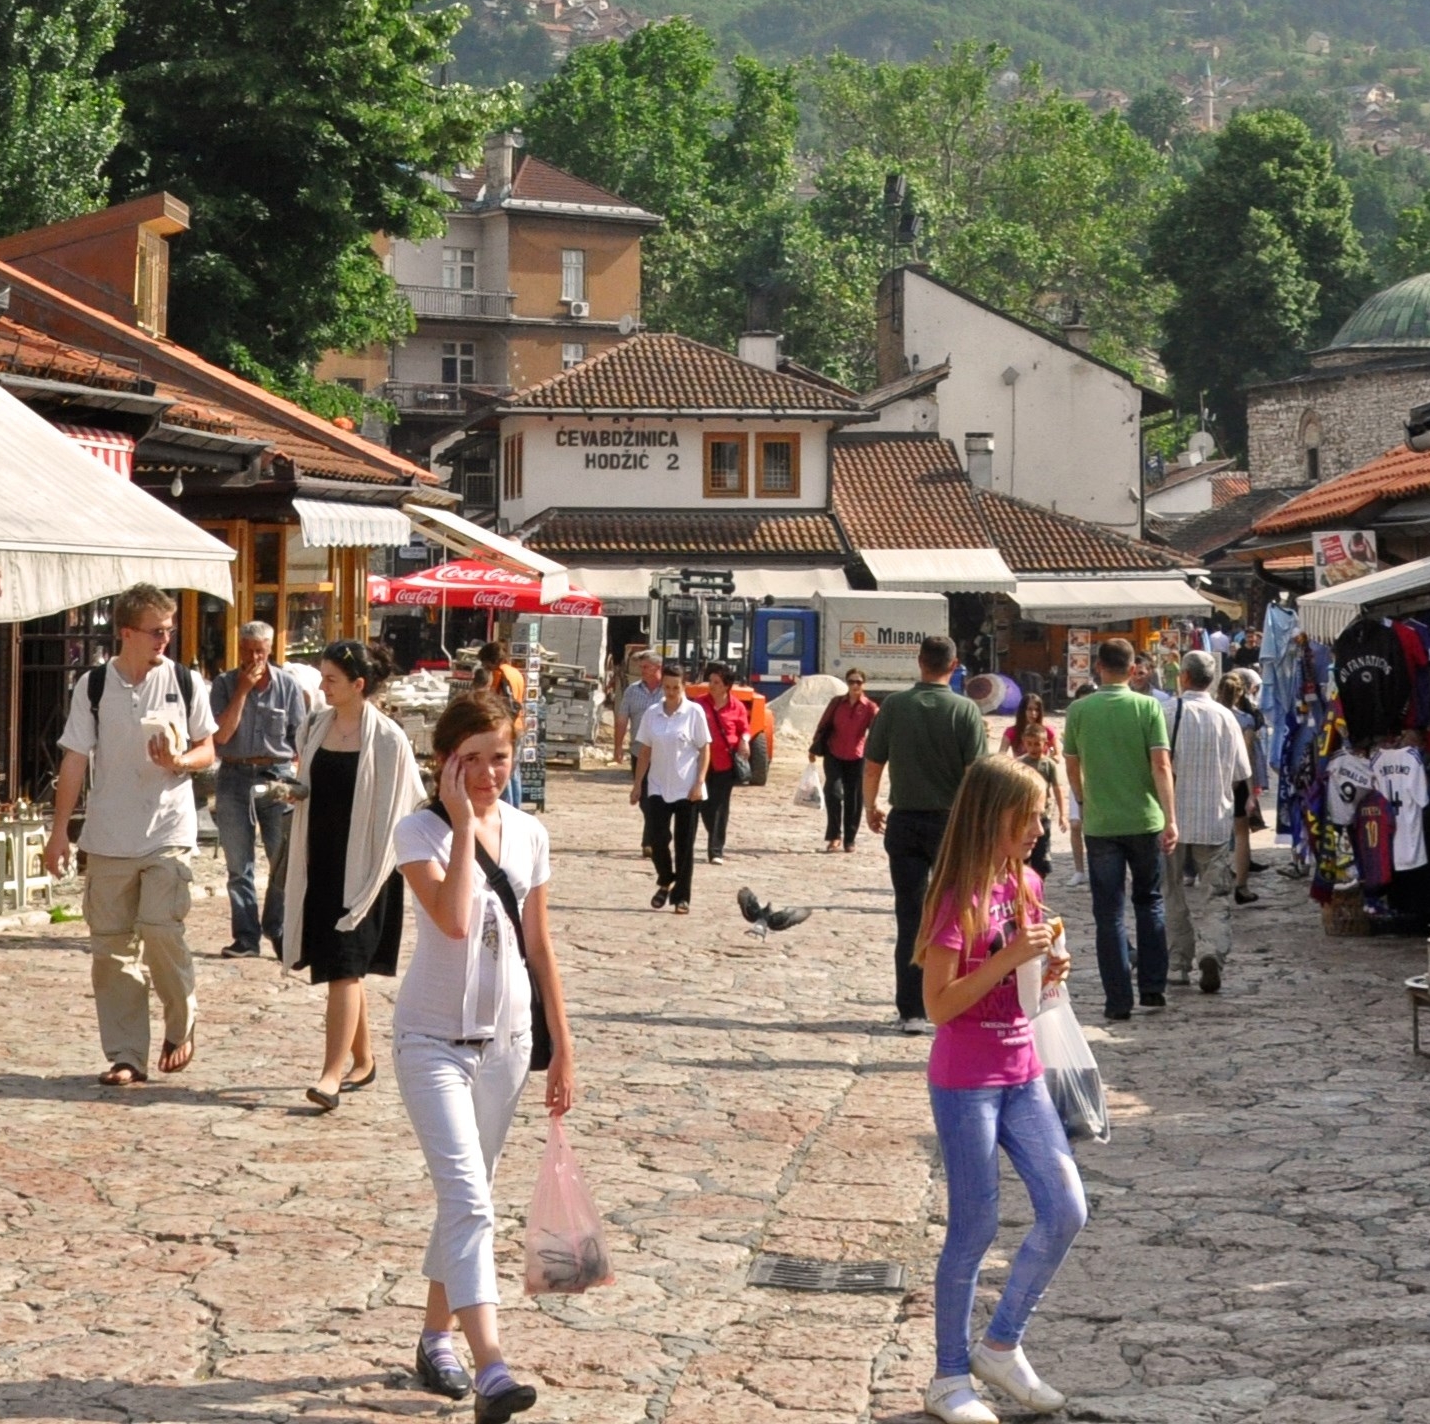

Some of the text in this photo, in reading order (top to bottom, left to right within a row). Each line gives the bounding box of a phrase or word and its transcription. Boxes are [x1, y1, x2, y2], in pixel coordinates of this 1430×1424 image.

[555, 426, 679, 447] ĆEVABDŽINICA
[585, 449, 680, 470] HODŽIĆ 2
[1339, 781, 1356, 804] 9
[1364, 820, 1379, 849] 10
